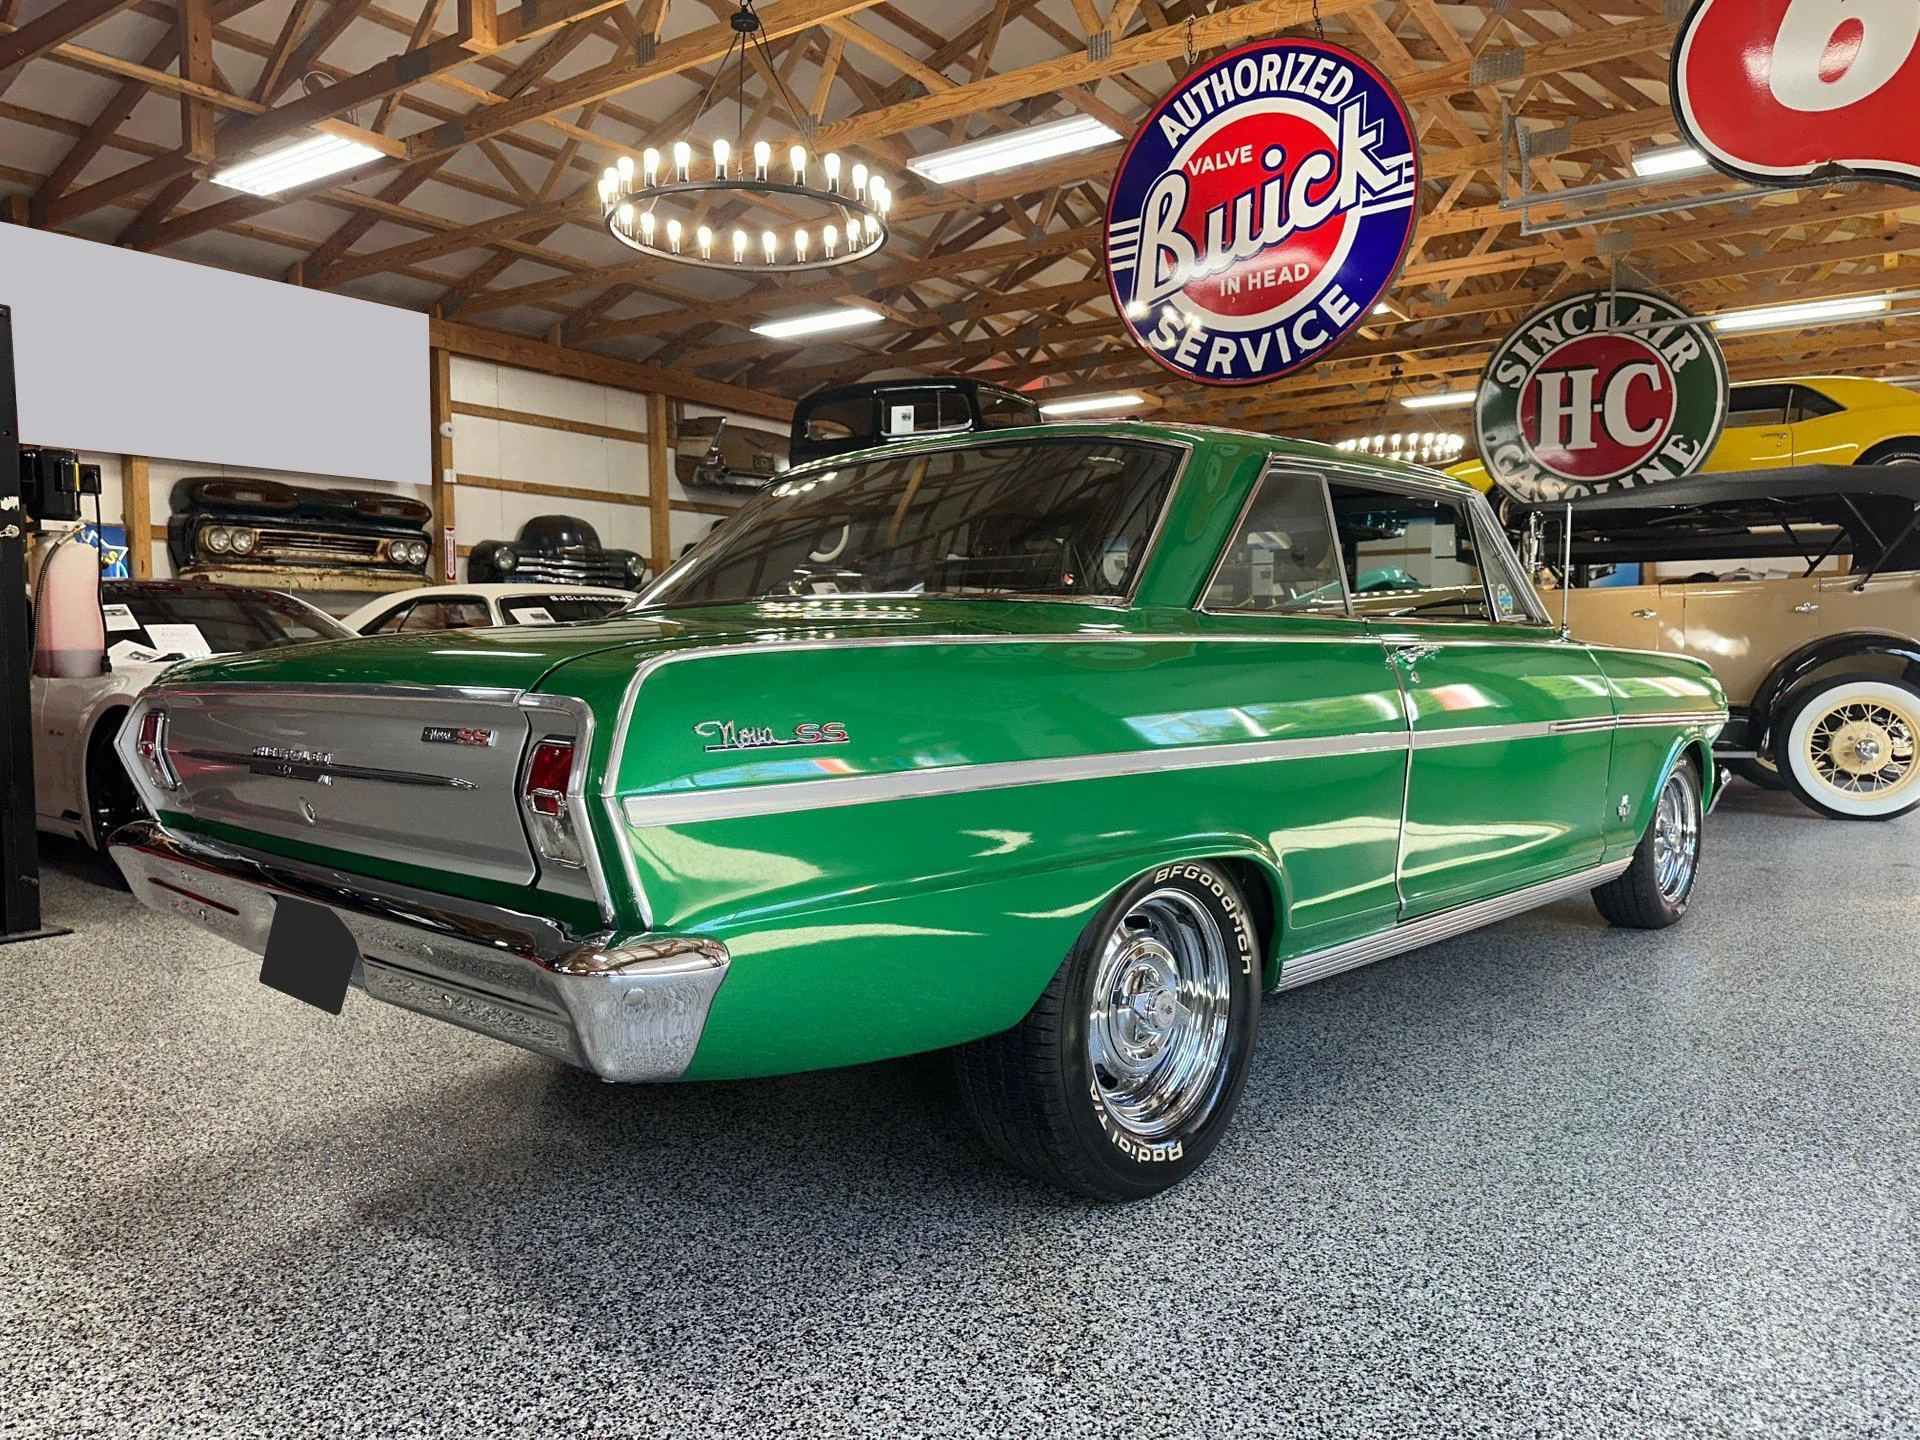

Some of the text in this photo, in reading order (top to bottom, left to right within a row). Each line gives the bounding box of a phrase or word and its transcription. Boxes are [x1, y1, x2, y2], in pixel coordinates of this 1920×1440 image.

[1158, 53, 1354, 149] AUTHORIZED
[1188, 144, 1253, 177] VALVE
[1131, 97, 1402, 311] Buick
[1219, 262, 1310, 297] IN HEAD
[1149, 284, 1359, 375] SERVICE
[1496, 301, 1701, 389] SINCLAIR
[458, 727, 489, 745] SS
[694, 720, 848, 749] Nova SS
[1154, 864, 1253, 975] BFGoodrich
[1111, 1130, 1184, 1162] Radial
